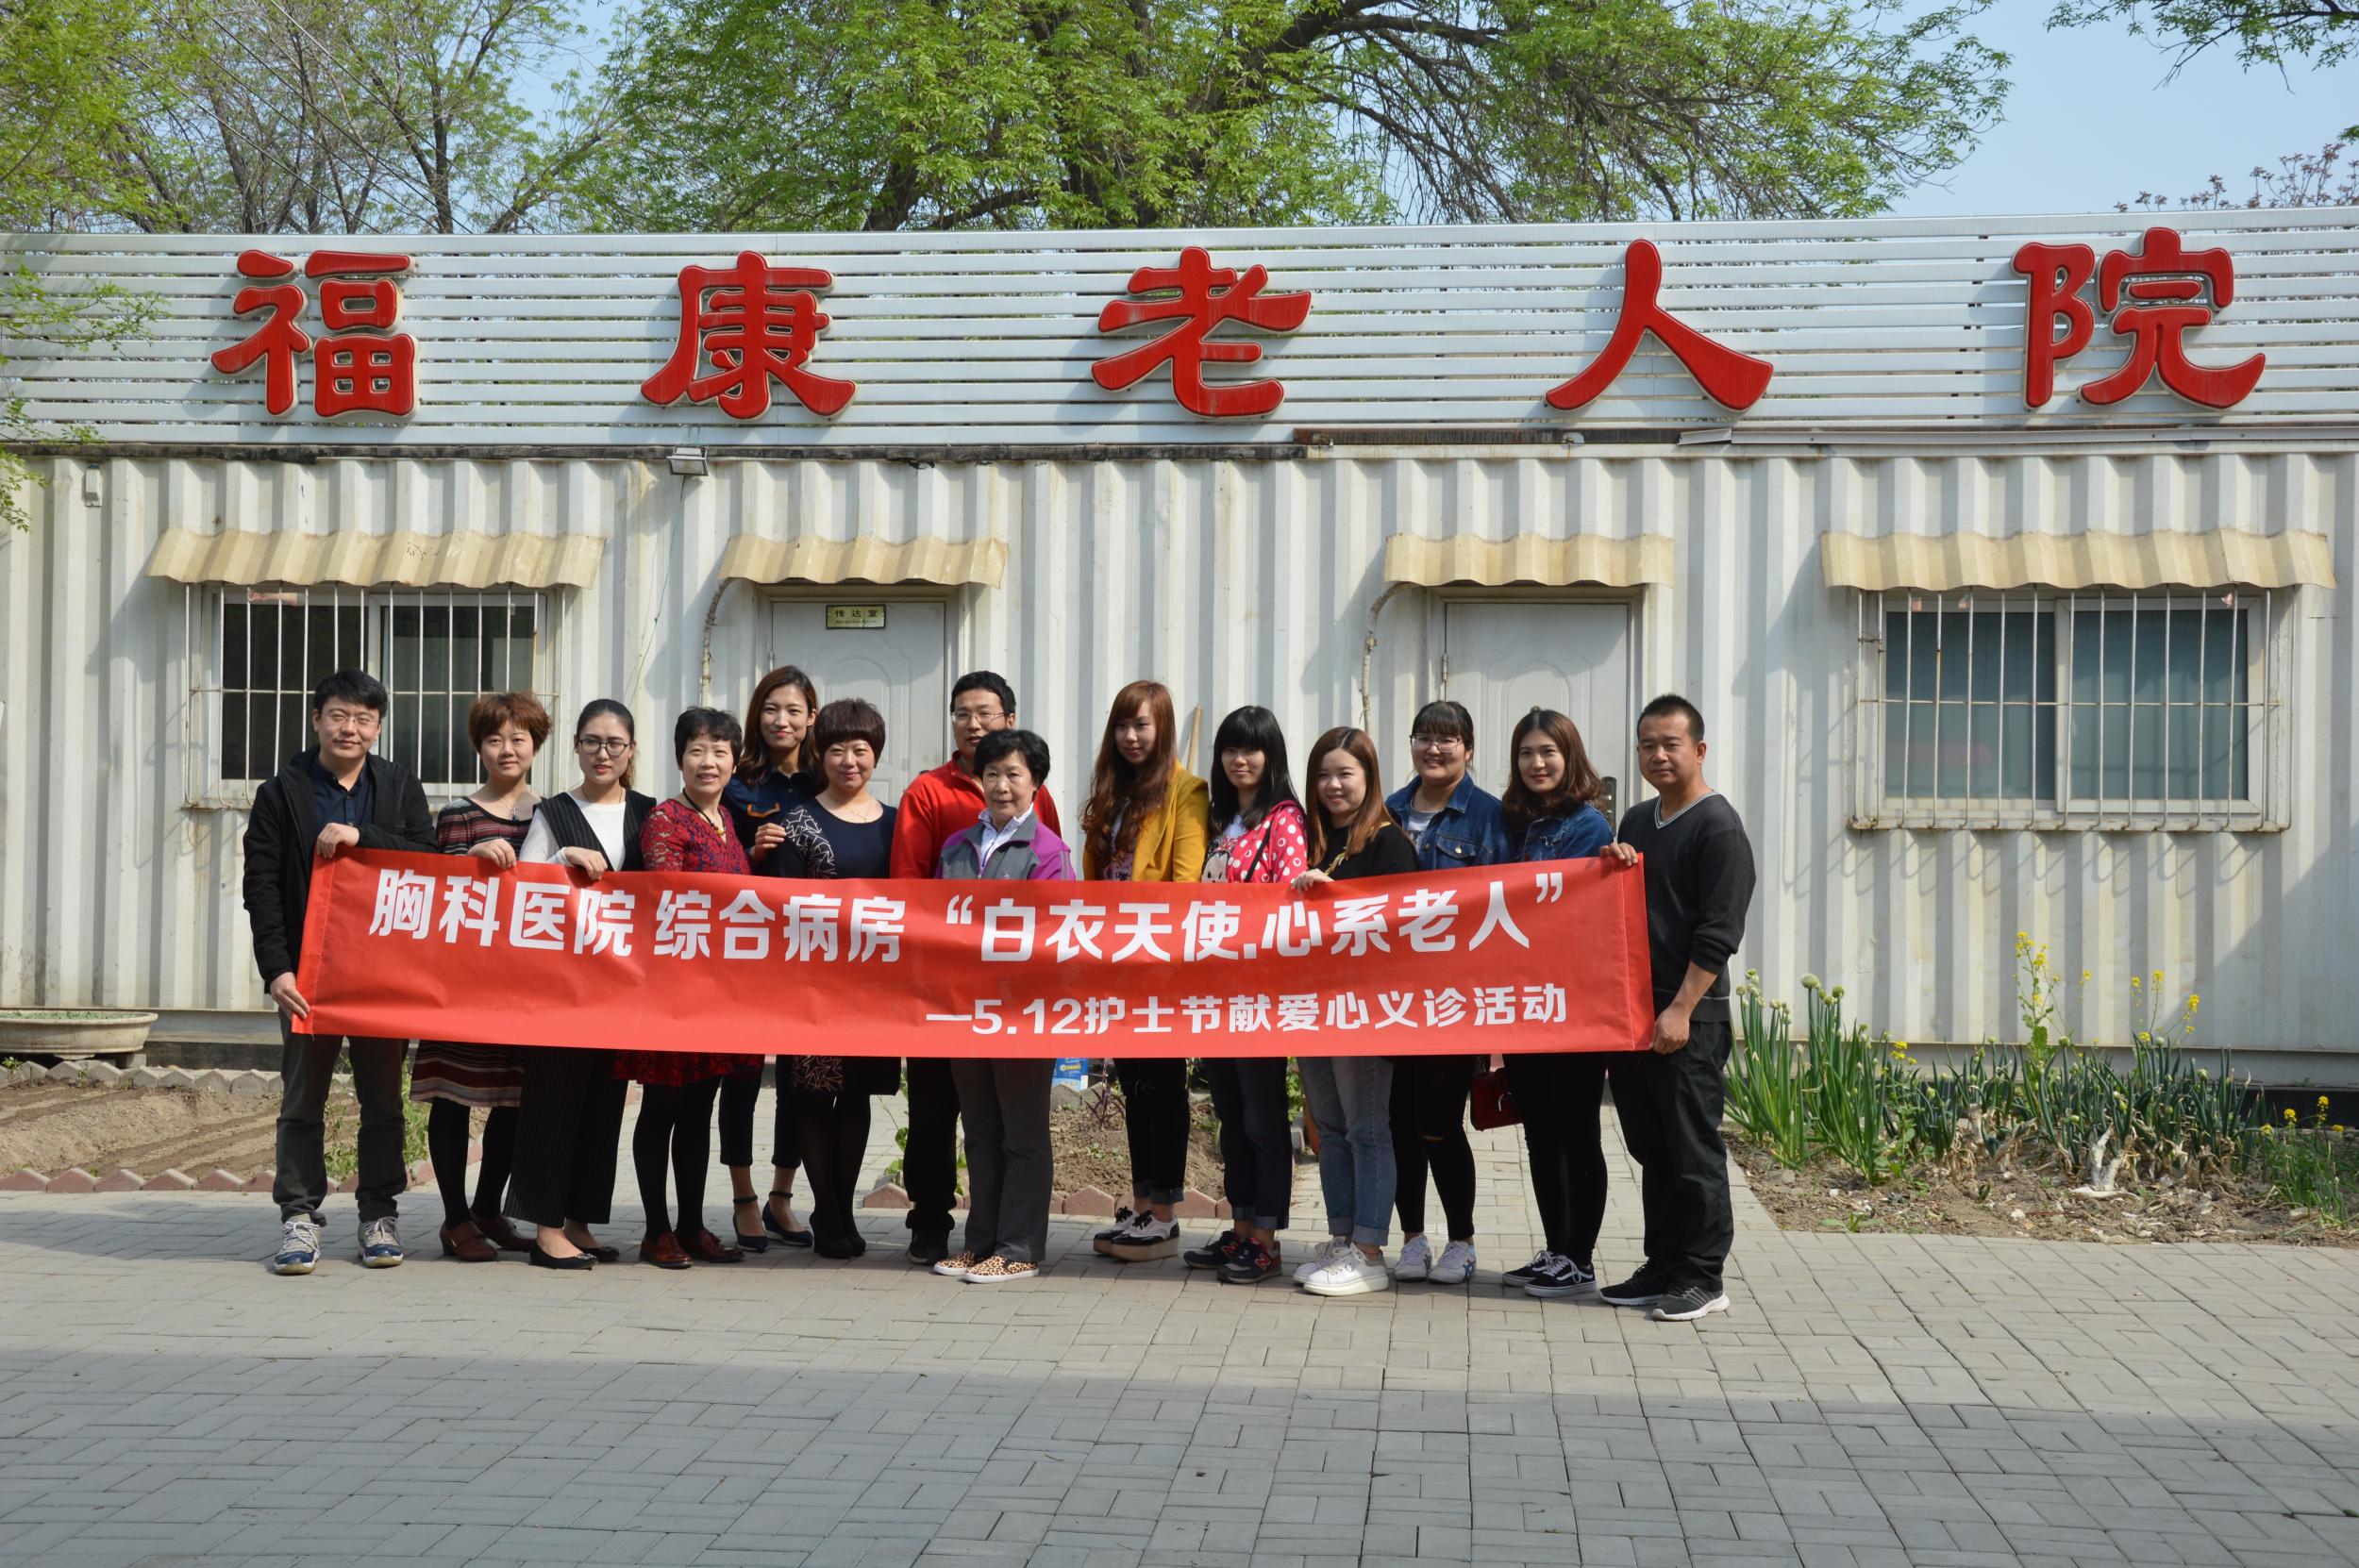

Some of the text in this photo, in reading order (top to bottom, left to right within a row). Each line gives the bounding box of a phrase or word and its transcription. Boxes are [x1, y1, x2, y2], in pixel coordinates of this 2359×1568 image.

[211, 229, 2266, 418] 福康老人院
[369, 868, 635, 958] 胸科医院
[654, 889, 906, 962] 综合病房
